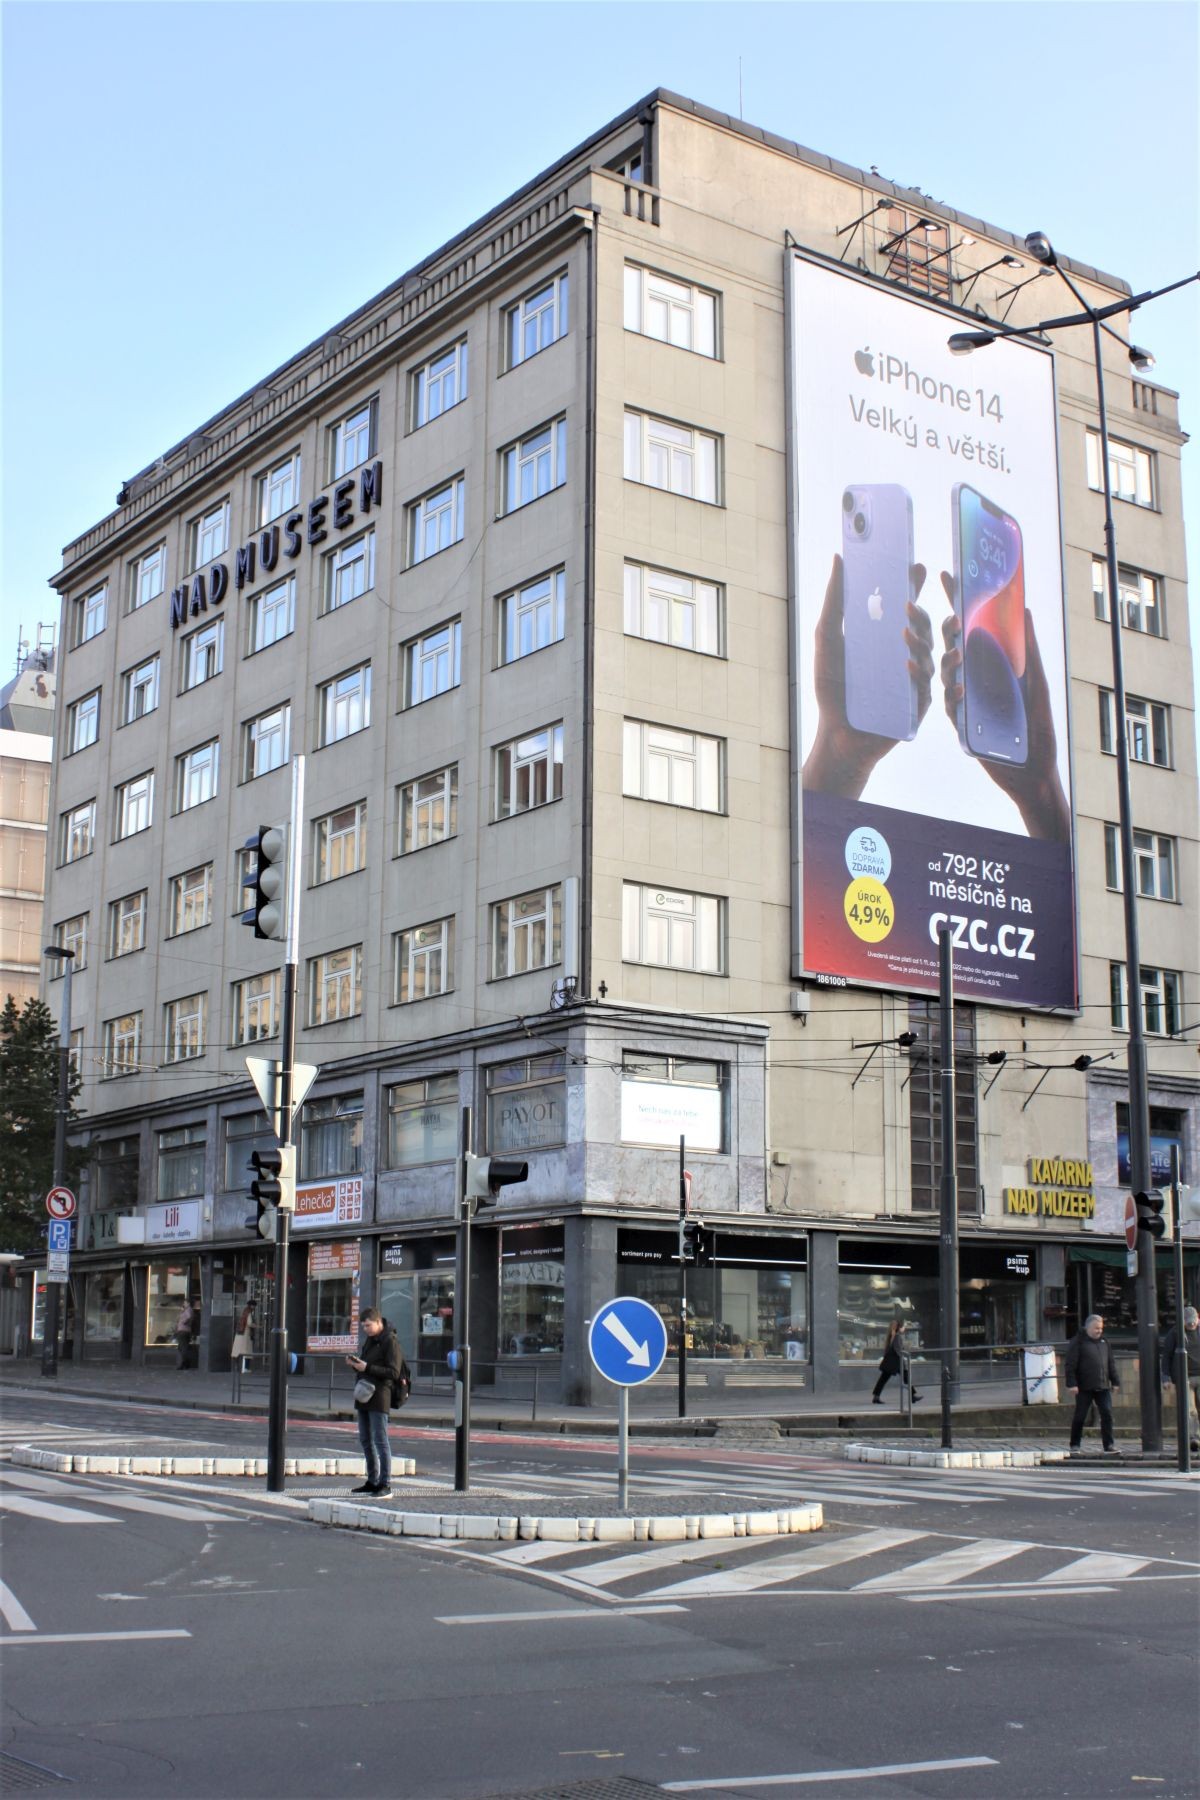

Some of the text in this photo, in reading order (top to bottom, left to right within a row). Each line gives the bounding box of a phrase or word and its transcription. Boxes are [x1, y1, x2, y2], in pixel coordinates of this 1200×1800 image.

[878, 352, 1004, 424] iPhone 14
[849, 394, 1011, 474] Velký a větší.
[170, 461, 383, 629] NAD MUSEEM
[852, 852, 885, 865] DOPRAVA
[852, 862, 885, 876] ZDARMA
[928, 861, 941, 872] od
[942, 852, 978, 879] 792
[857, 889, 882, 904] ÚROK
[929, 878, 1033, 914] měsíčně na
[929, 912, 1036, 961] CZC.CZ
[816, 973, 846, 987] 1861006
[501, 1101, 556, 1127] PAYOT
[1029, 1155, 1094, 1187] KAVÁRNA
[296, 1191, 332, 1212] Lehečka
[1003, 1187, 1038, 1216] NAD
[165, 1206, 179, 1228] Lili
[53, 1223, 66, 1242] P
[391, 1256, 403, 1266] kup
[621, 1250, 644, 1258] sortiment
[1007, 1256, 1028, 1268] psina
[1015, 1264, 1030, 1275] kup
